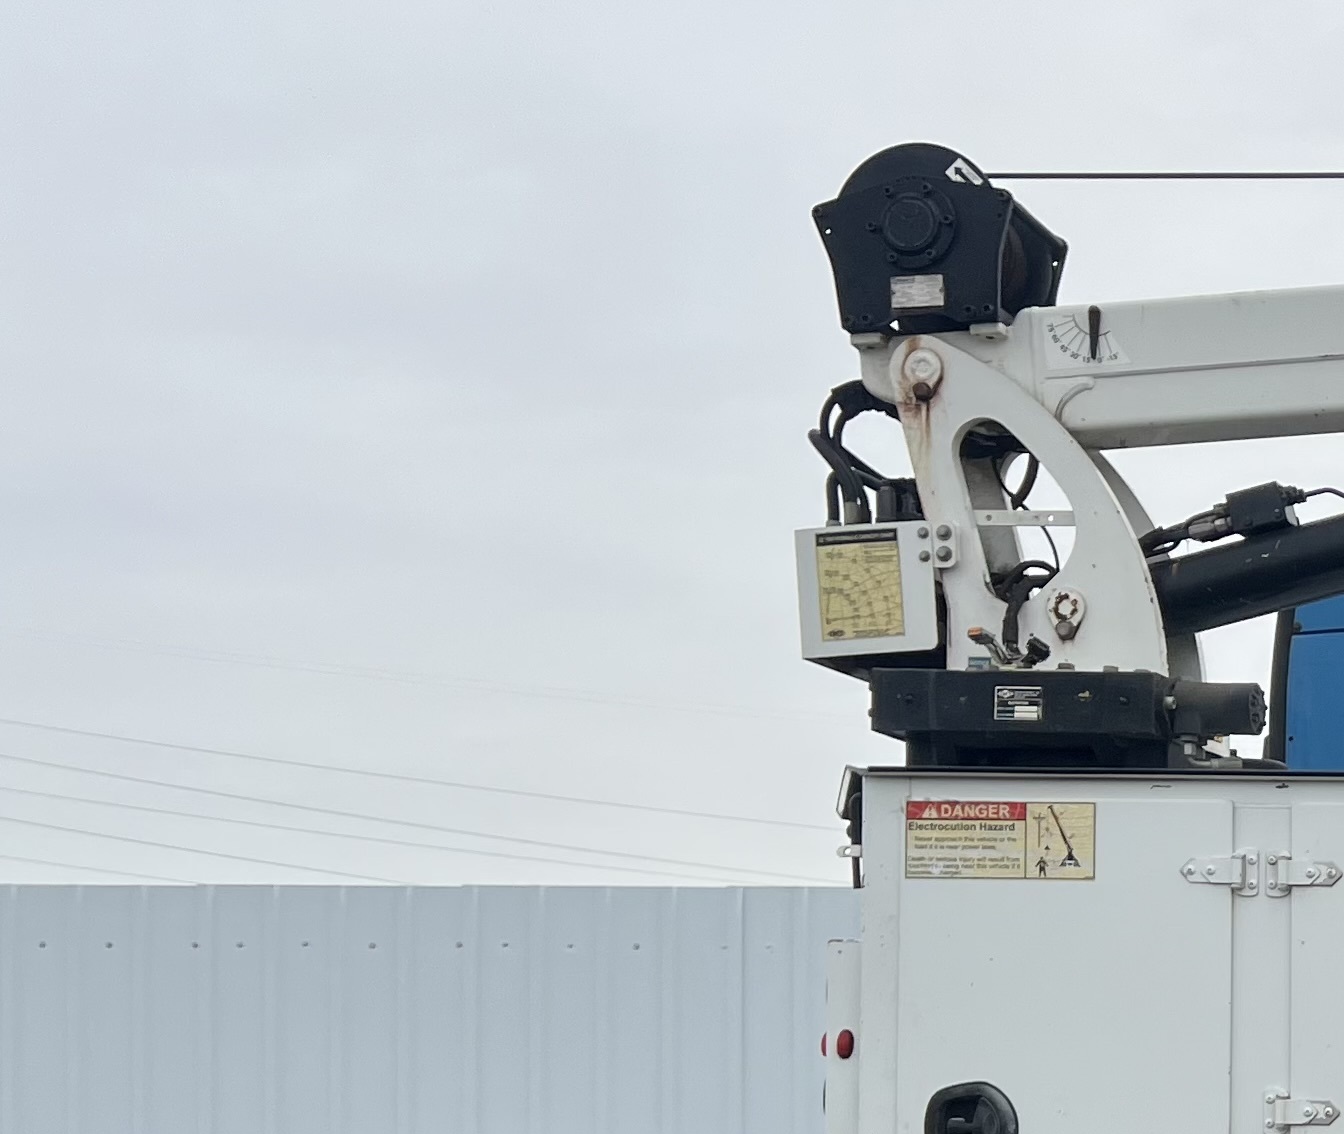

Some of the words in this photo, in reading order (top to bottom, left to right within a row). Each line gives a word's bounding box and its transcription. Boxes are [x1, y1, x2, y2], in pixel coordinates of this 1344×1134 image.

[941, 804, 1010, 818] DANGER
[908, 822, 976, 832] Electrocution
[980, 822, 1015, 832] Hazard
